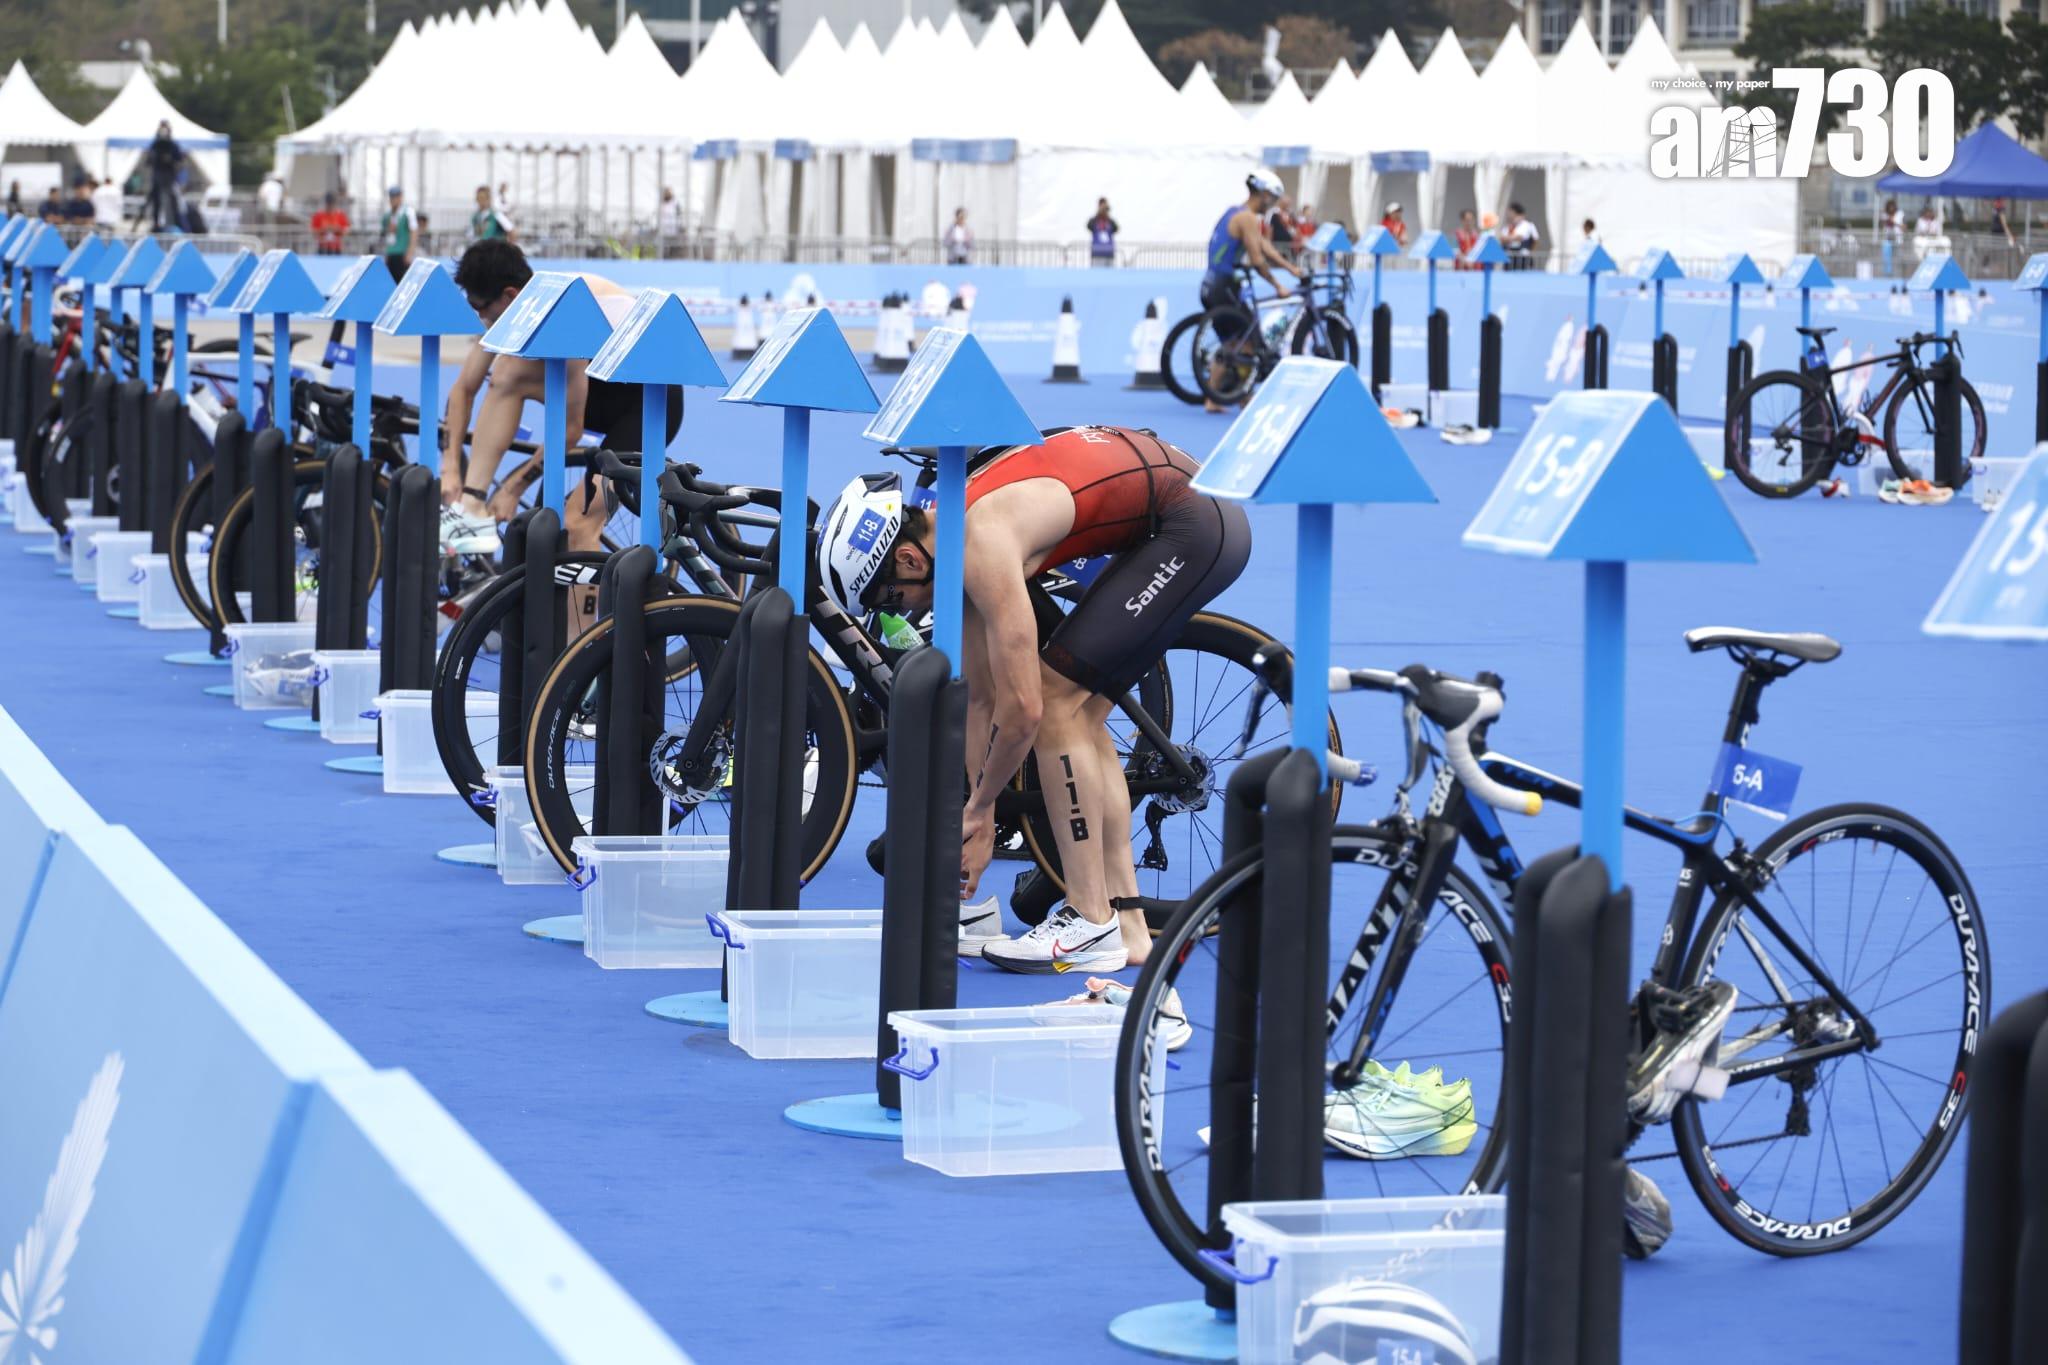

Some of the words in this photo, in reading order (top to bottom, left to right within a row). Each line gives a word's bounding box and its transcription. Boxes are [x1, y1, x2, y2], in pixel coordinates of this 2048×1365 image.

[1514, 432, 1605, 498] 15-B
[850, 516, 899, 596] SPECIALIZED
[858, 519, 878, 542] 11-B
[1125, 556, 1185, 617] Santic
[815, 585, 892, 696] TRE
[1060, 754, 1089, 842] 11-B
[1949, 893, 1981, 1056] DURA-ACE
[1733, 1199, 1851, 1240] DURA-ACE
